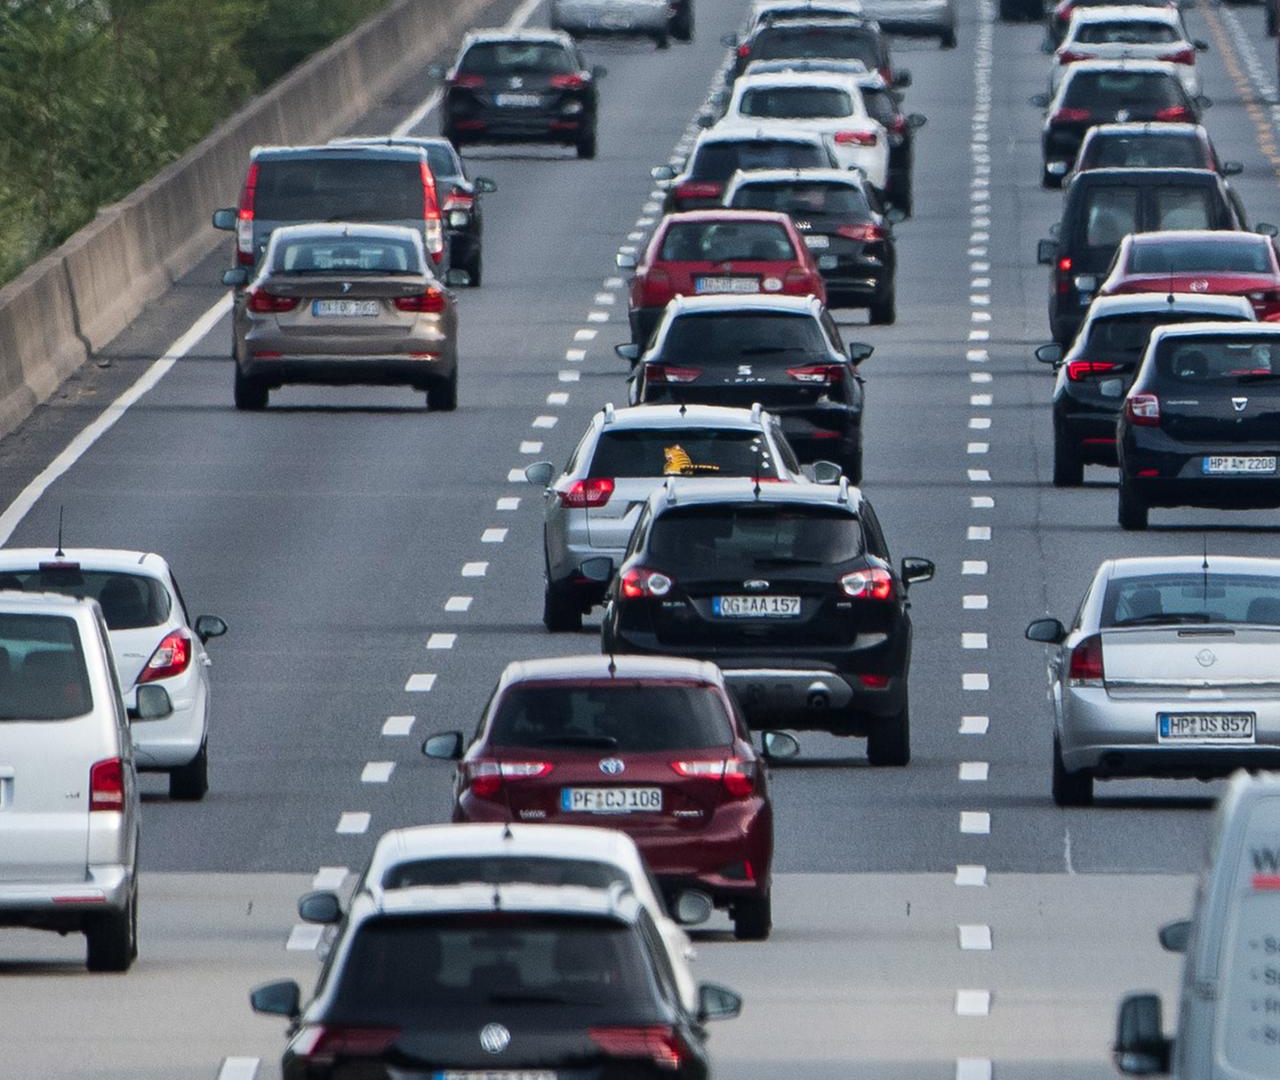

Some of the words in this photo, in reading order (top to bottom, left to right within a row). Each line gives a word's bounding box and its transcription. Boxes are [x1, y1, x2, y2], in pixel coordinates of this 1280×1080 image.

[750, 598, 768, 613] AA
[773, 598, 798, 613] 157
[1222, 718, 1250, 733] 857
[573, 792, 593, 807] PF
[605, 792, 627, 807] CJ
[631, 792, 661, 807] 108
